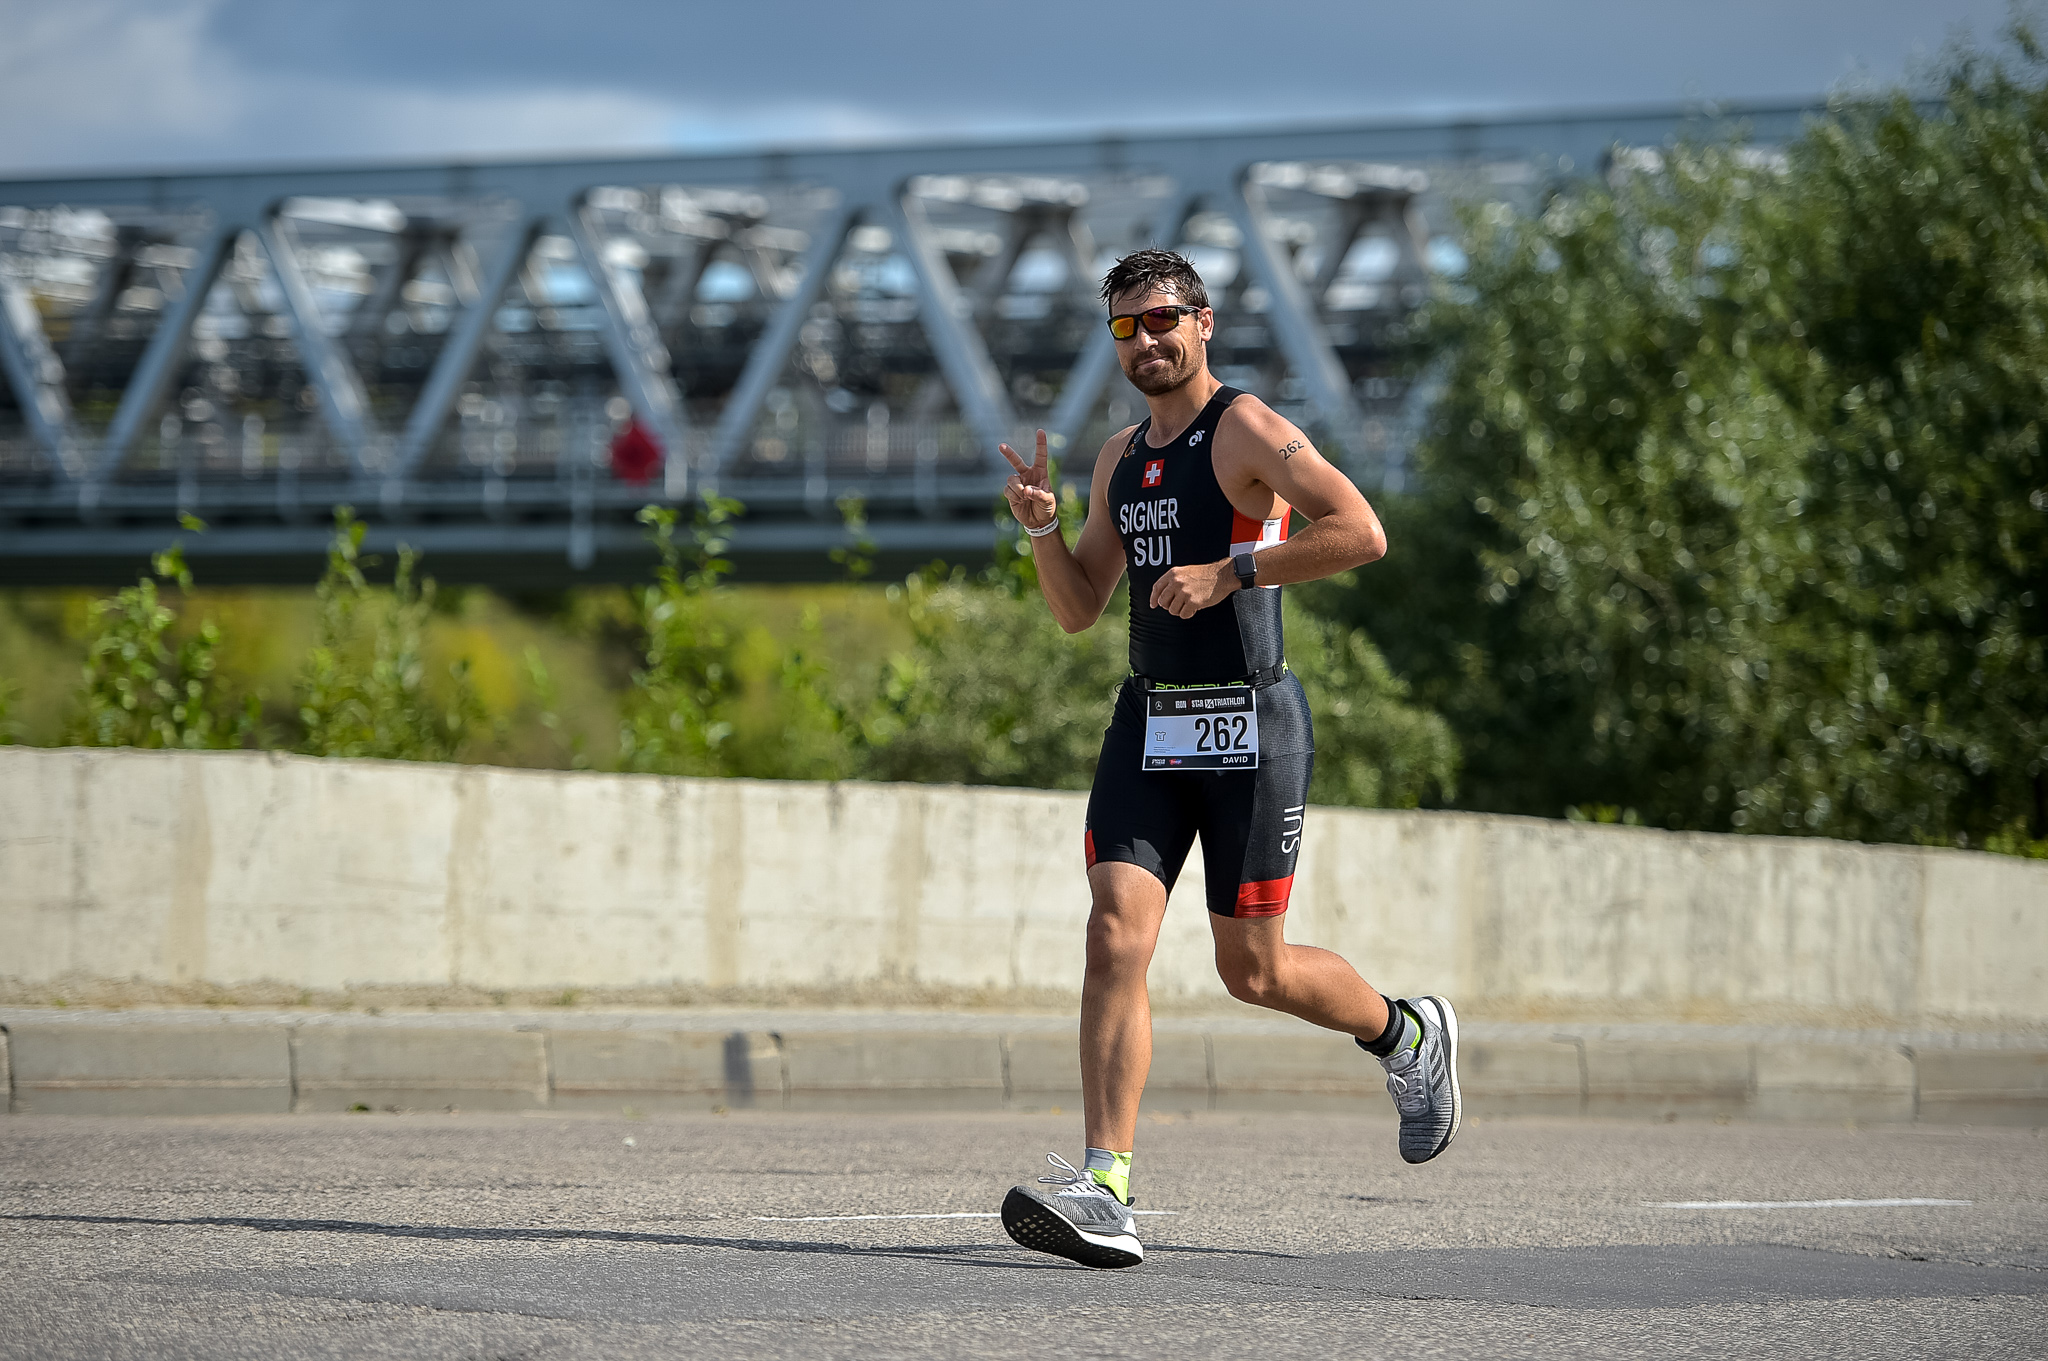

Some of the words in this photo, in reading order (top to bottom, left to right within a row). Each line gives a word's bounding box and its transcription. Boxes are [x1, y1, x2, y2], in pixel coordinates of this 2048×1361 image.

[1278, 440, 1304, 460] 262
[1119, 497, 1180, 535] SIGNER
[1133, 535, 1172, 567] SUI
[1155, 680, 1244, 690] POWEP
[1214, 696, 1245, 707] TRIATHLON
[1194, 715, 1249, 752] 262
[1222, 755, 1248, 764] DAVID
[1281, 804, 1304, 854] SUI
